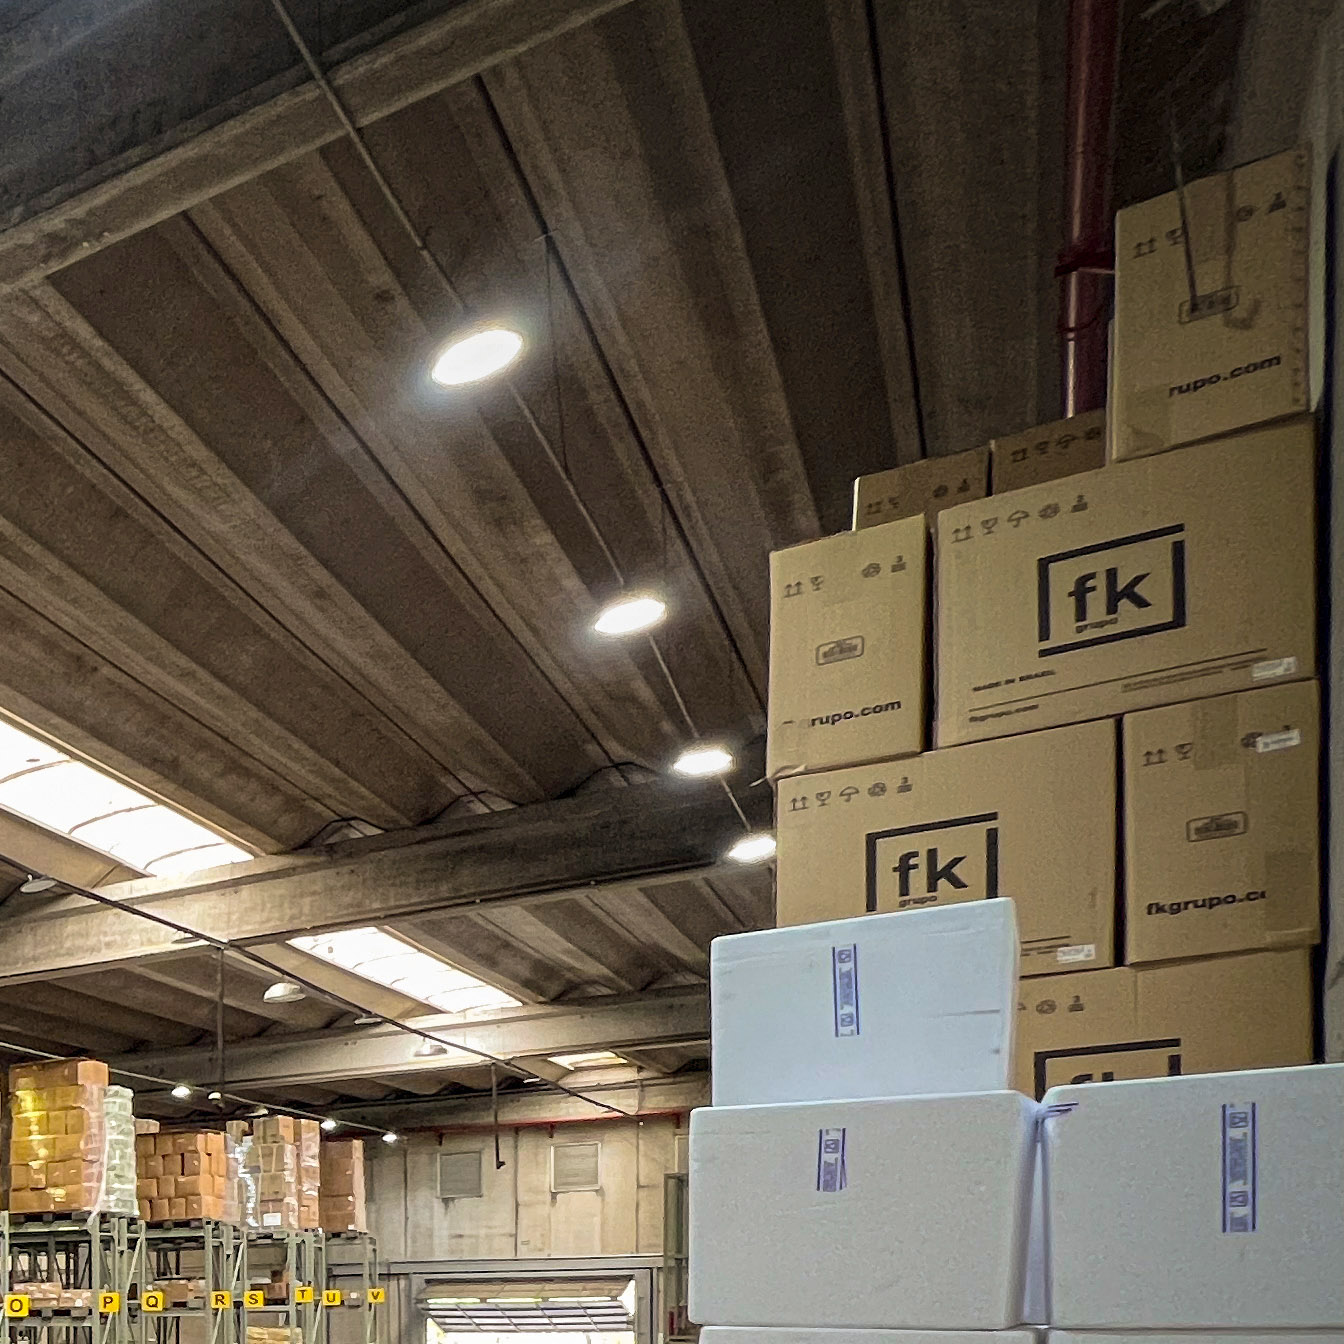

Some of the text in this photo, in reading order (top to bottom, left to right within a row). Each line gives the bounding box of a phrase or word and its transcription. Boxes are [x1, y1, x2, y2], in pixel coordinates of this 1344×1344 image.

[1169, 355, 1281, 397] rupo.com
[1068, 567, 1152, 622] fk
[892, 847, 969, 897] fk
[1146, 890, 1267, 916] fkgrupo.c
[214, 1294, 226, 1306] R
[248, 1294, 259, 1305] S
[298, 1289, 307, 1299] T
[326, 1292, 336, 1303] U
[371, 1291, 381, 1301] V
[9, 1298, 23, 1313] O
[103, 1296, 114, 1309] P
[145, 1295, 159, 1309] Q
